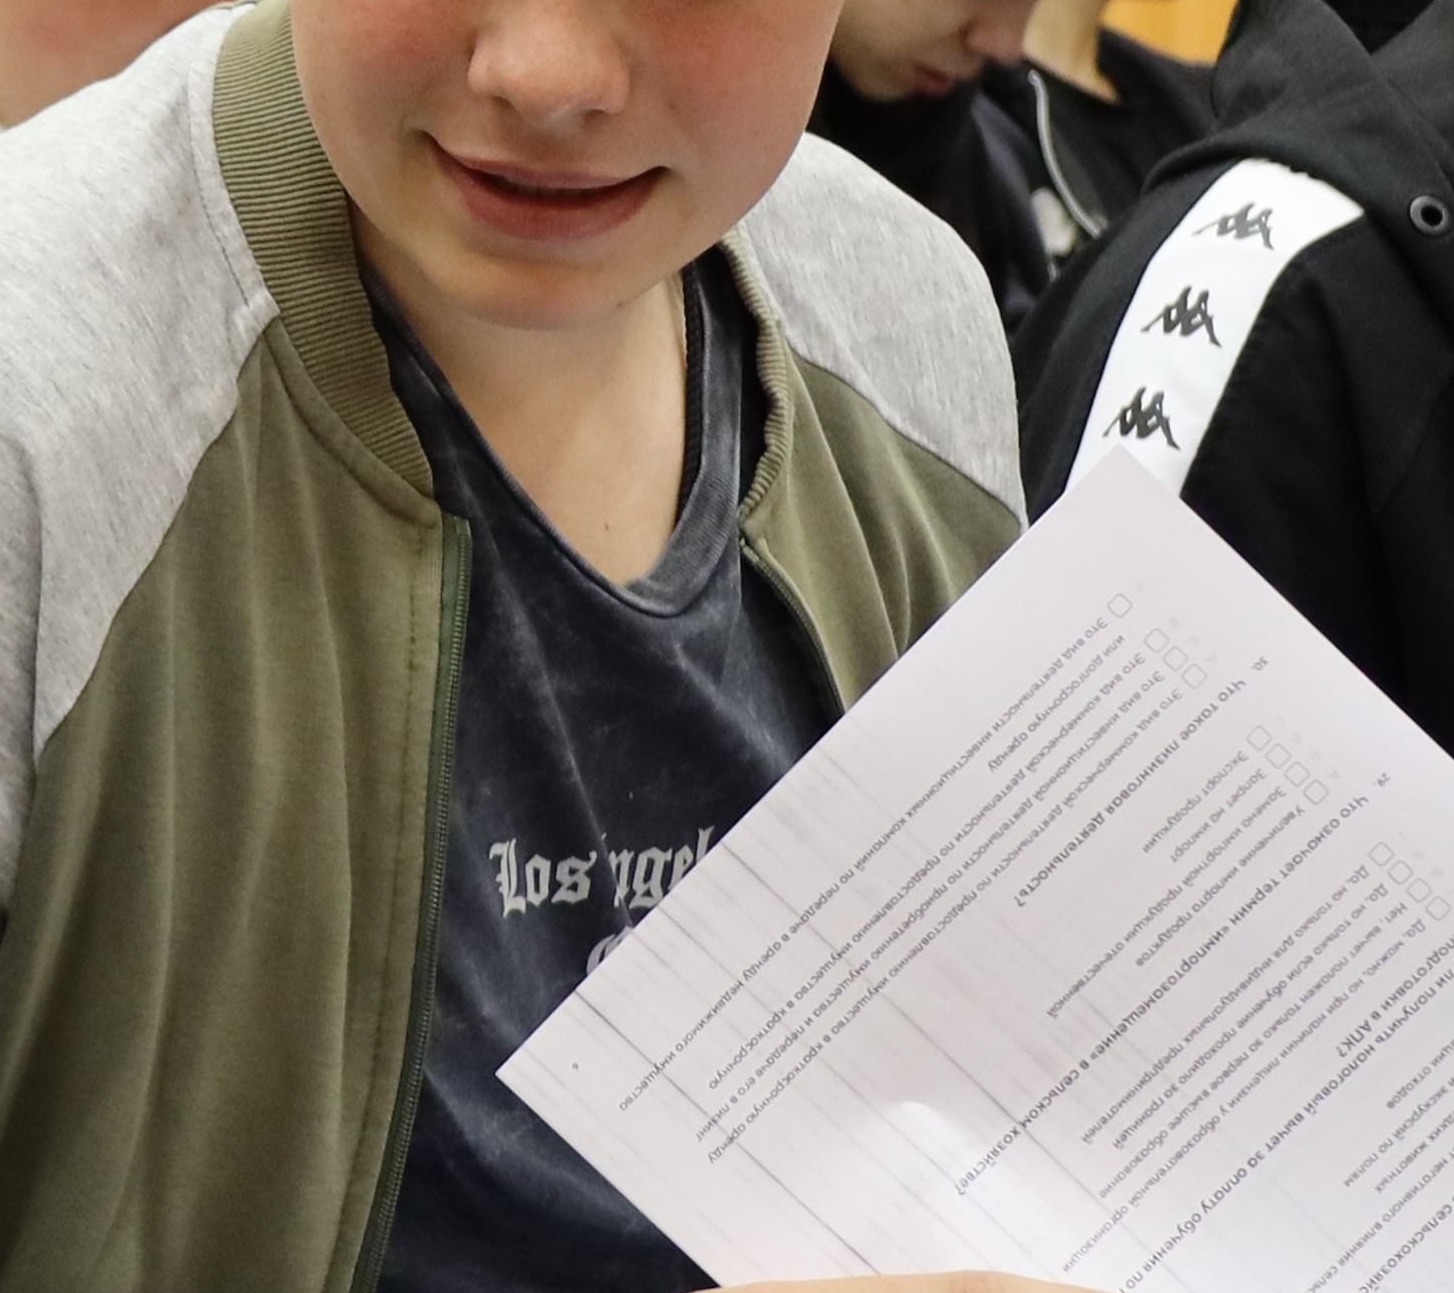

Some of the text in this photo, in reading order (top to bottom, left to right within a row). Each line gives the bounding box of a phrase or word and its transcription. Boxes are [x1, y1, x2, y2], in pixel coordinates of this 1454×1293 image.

[983, 652, 1104, 773] долгосрочную аренду
[785, 657, 1065, 935] деятельности инвестиционных компаний передаче
[1009, 675, 1246, 908] Что такое лизинговая деятельность?
[1138, 748, 1249, 853] Экспорт продукции
[1166, 766, 1268, 863] Запрет импорт
[489, 838, 598, 919] Los
[692, 711, 1123, 1142] инвестиционной деятельности приобретению имущества передаче лизинг
[704, 692, 1104, 1090] коммерческой деятельности предоставлению имущества краткосрочную
[1044, 785, 1286, 1019] Замена импортной продукции отечественной
[1131, 803, 1305, 967] Увеличение импорта продуктов
[704, 728, 1142, 1164] коммерческой деятельности предоставлению имущества краткосрочную аренду
[951, 791, 1368, 1196] Что означает термин «импортозамещение» сельском хозяйстве?
[1078, 899, 1333, 1145] только индивидуальных предпринимателей
[1095, 900, 1408, 1201] Нет, вычет положен только первое высшее образование
[1109, 917, 1352, 1151] только если обучение проходило границей
[1332, 1018, 1375, 1059] АПК?
[1370, 983, 1437, 1046] получить
[1058, 938, 1405, 1273] можно, наличии лицензии образовательной организации
[1301, 1043, 1376, 1114] налоговый
[1383, 1063, 1432, 1110] отходов
[1389, 1082, 1451, 1142] экскурсий
[1262, 1111, 1305, 1152] вычет
[1341, 1151, 1379, 1188] полям
[1373, 1140, 1429, 1193] животных
[1196, 1163, 1249, 1215] оплату
[1379, 1156, 1449, 1224] негативного
[1138, 1209, 1206, 1275] обучения
[1335, 1220, 1383, 1267] влияния
